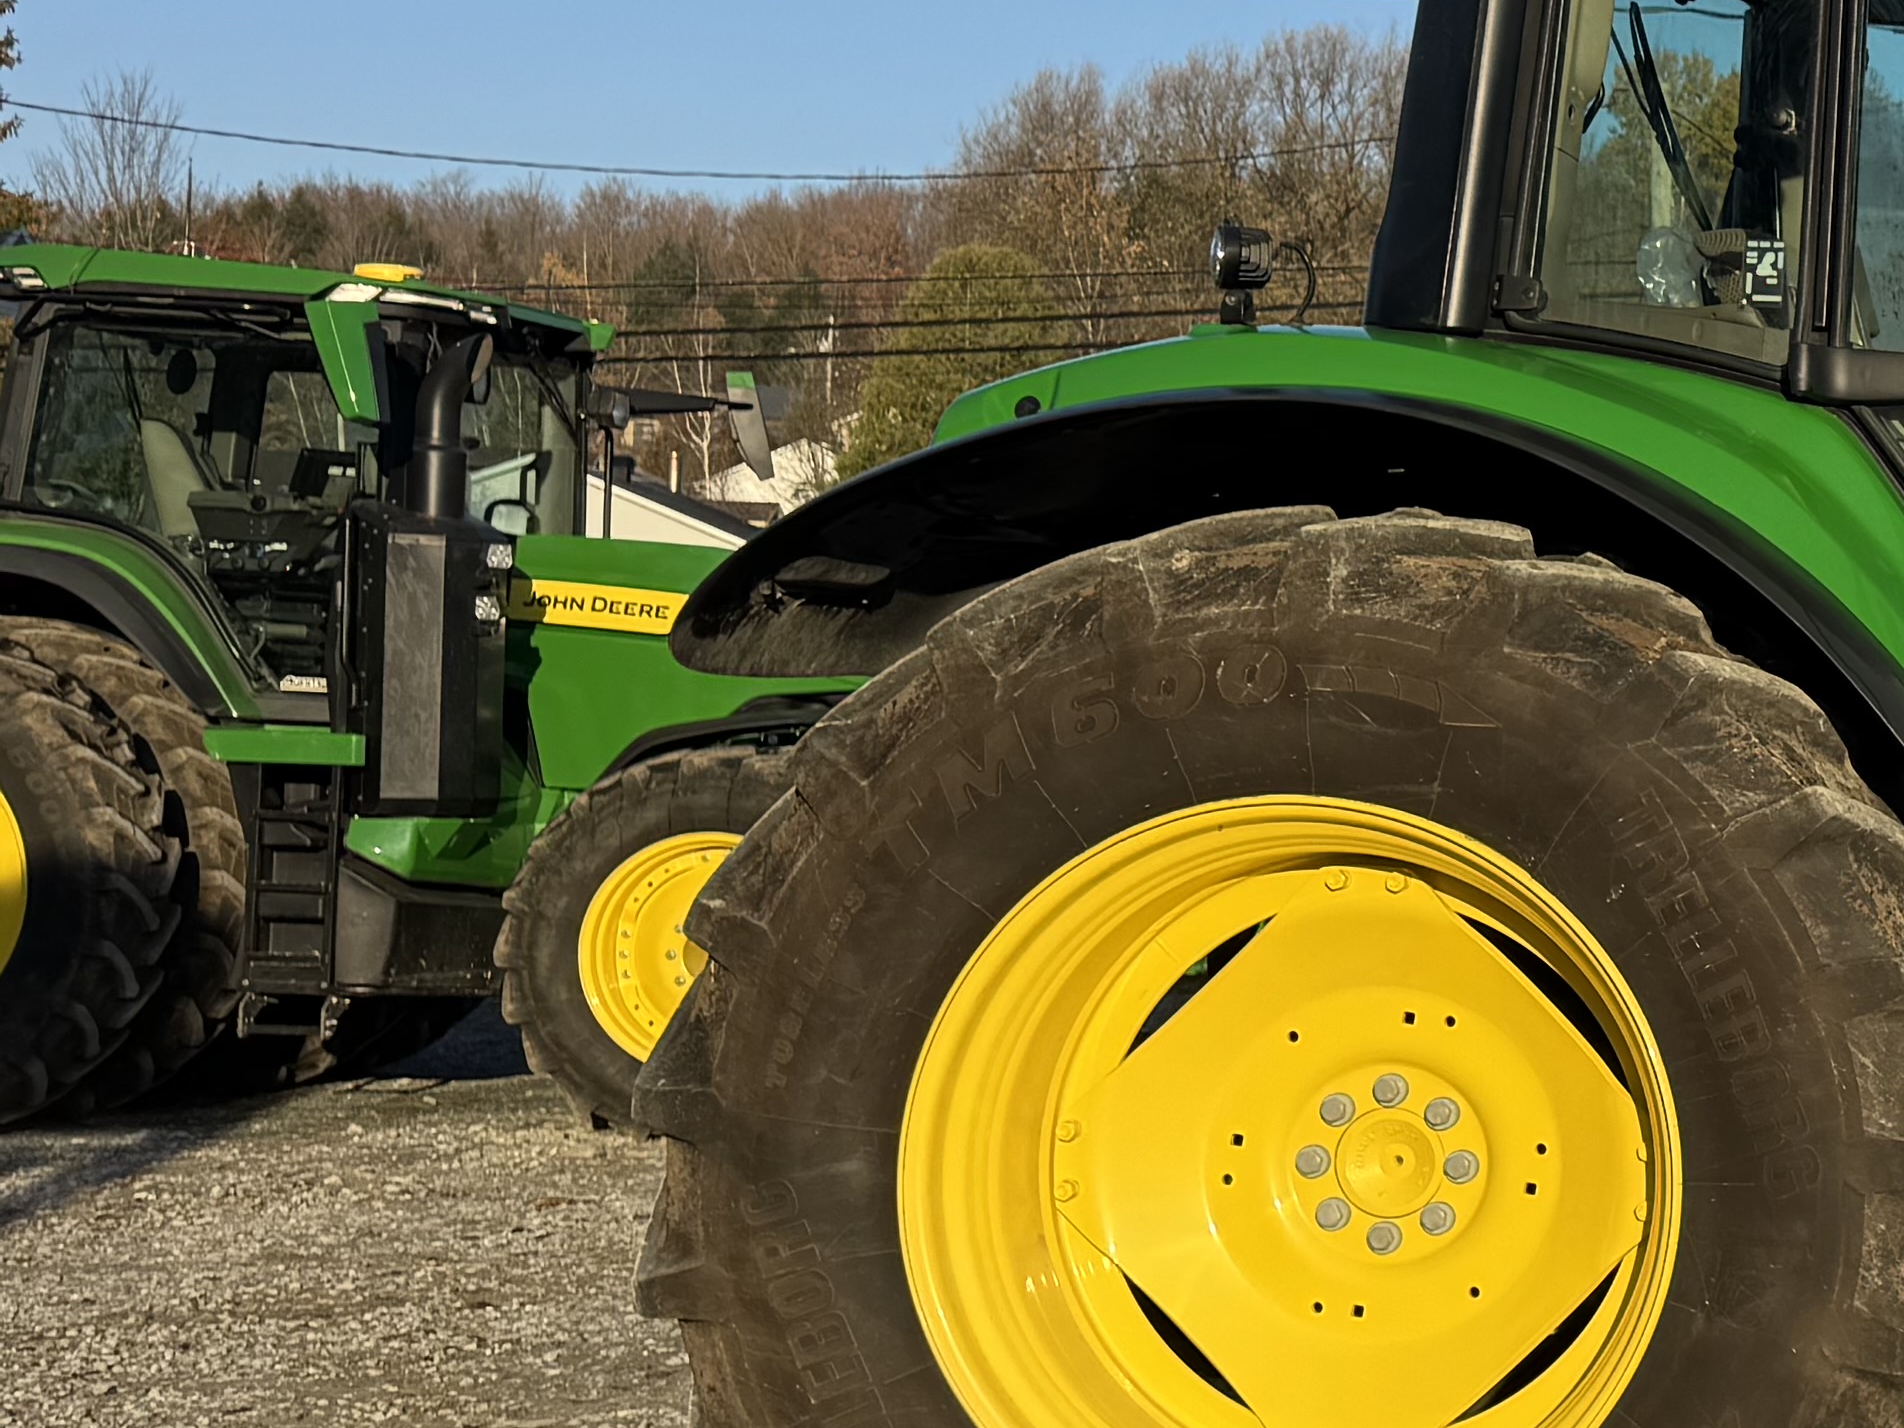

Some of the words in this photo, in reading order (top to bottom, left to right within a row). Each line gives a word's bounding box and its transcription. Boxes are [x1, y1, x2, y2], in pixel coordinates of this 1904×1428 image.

[523, 590, 585, 612] JOHN
[591, 595, 671, 620] DEERE
[1608, 787, 1821, 1200] TRELLEBORG
